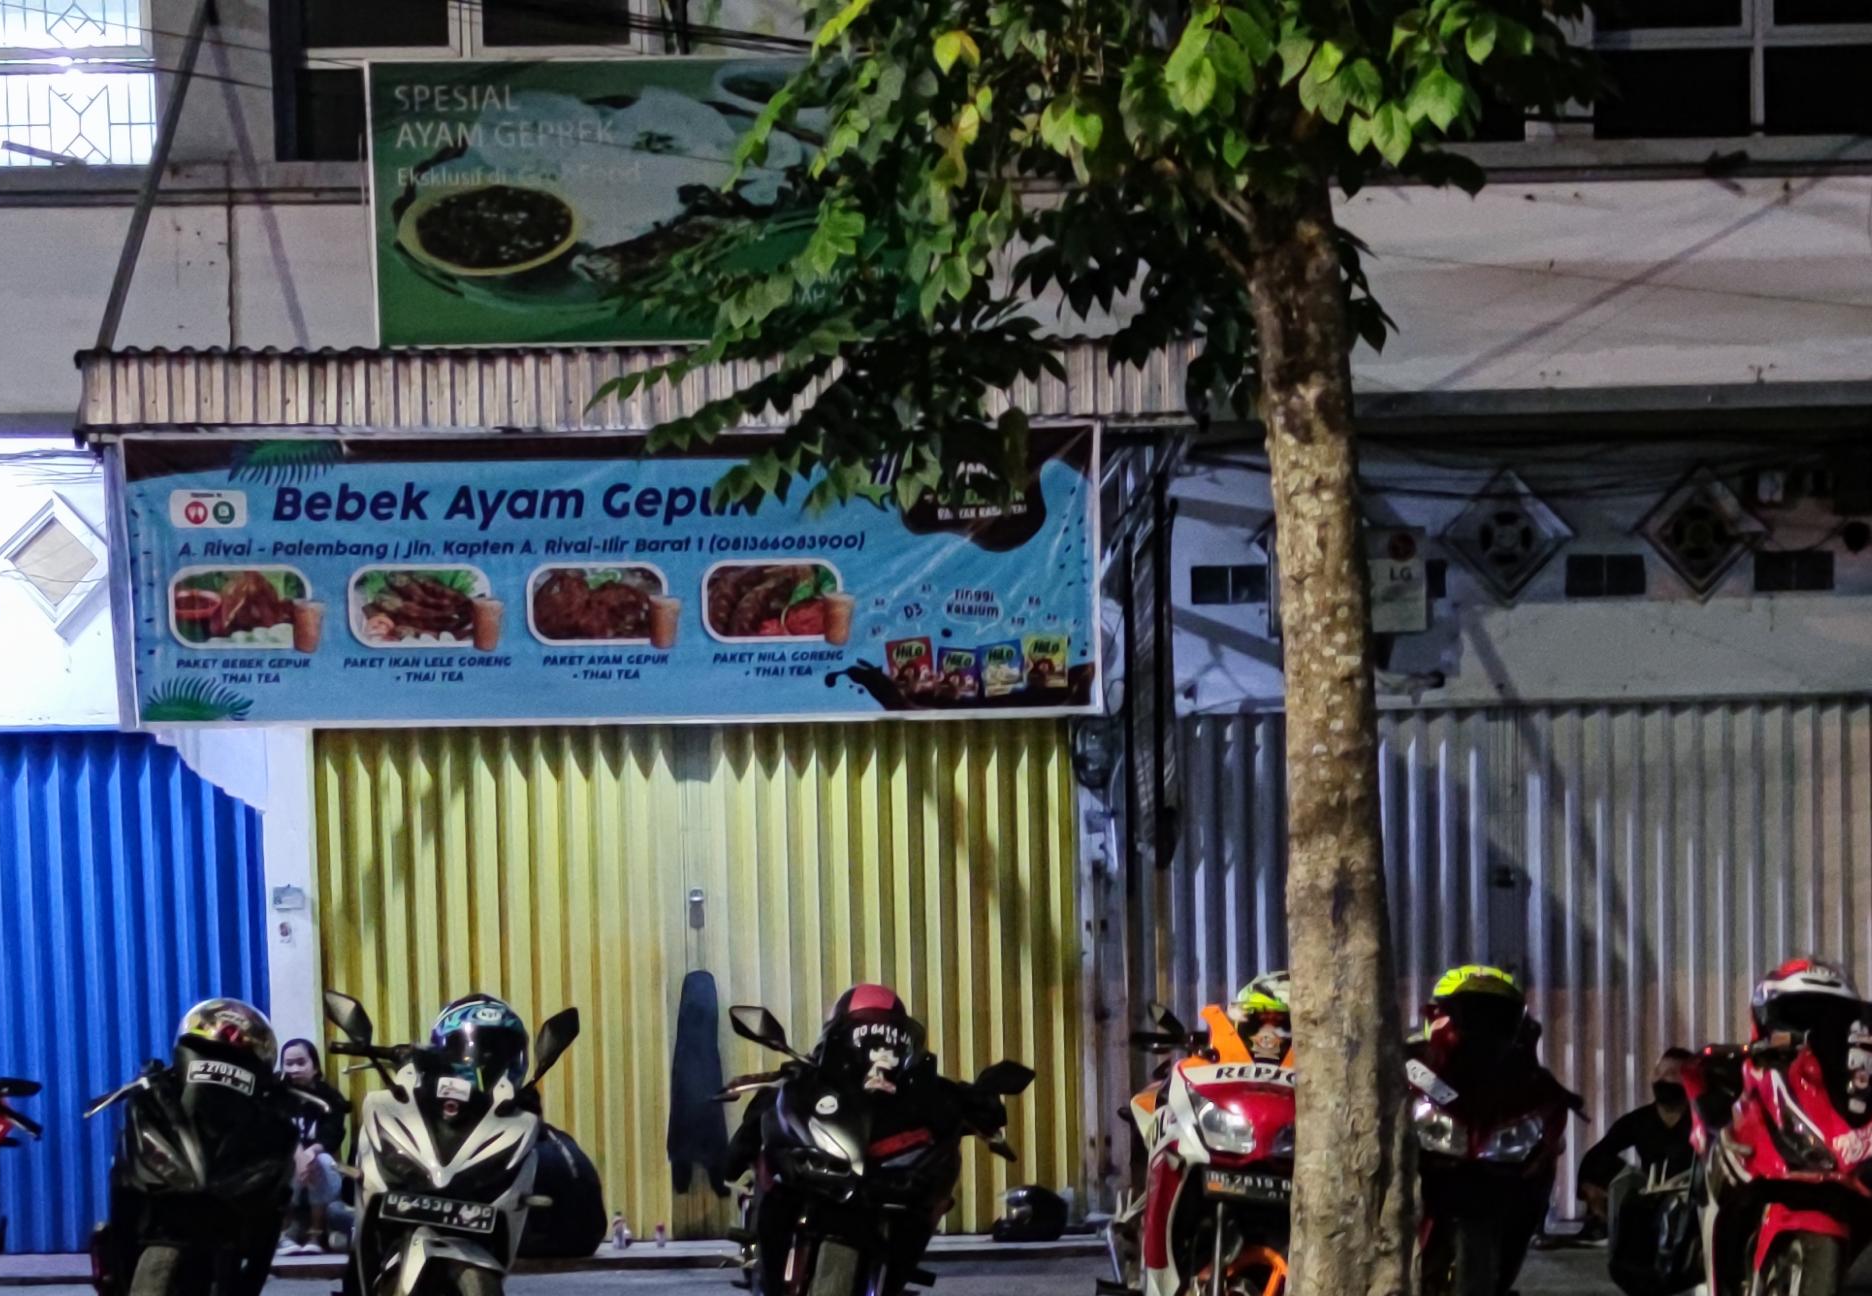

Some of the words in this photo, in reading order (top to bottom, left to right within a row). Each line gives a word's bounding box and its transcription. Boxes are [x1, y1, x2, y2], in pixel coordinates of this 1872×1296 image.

[394, 84, 521, 112] SPESIAL
[395, 120, 485, 149] AYAM
[272, 481, 430, 522] Bebek
[443, 484, 587, 531] Ayam
[179, 541, 197, 558] A.
[203, 538, 253, 557] Rivai
[272, 538, 389, 560] Palembang
[442, 538, 515, 560] Kapten
[519, 538, 538, 555] A.
[635, 534, 692, 554] Barat
[343, 658, 384, 669] PAKET
[424, 657, 454, 668] LELE
[542, 655, 585, 667] PAKET
[587, 655, 623, 666] AYAM
[712, 652, 755, 665] PAKET
[406, 671, 436, 683] THAI
[441, 671, 465, 682] TEA
[582, 669, 613, 680] THAI
[617, 669, 641, 680] TEA
[755, 666, 784, 677] THAI
[789, 665, 814, 677] TEA
[257, 673, 281, 684] TEA
[1215, 1064, 1297, 1083] REPS
